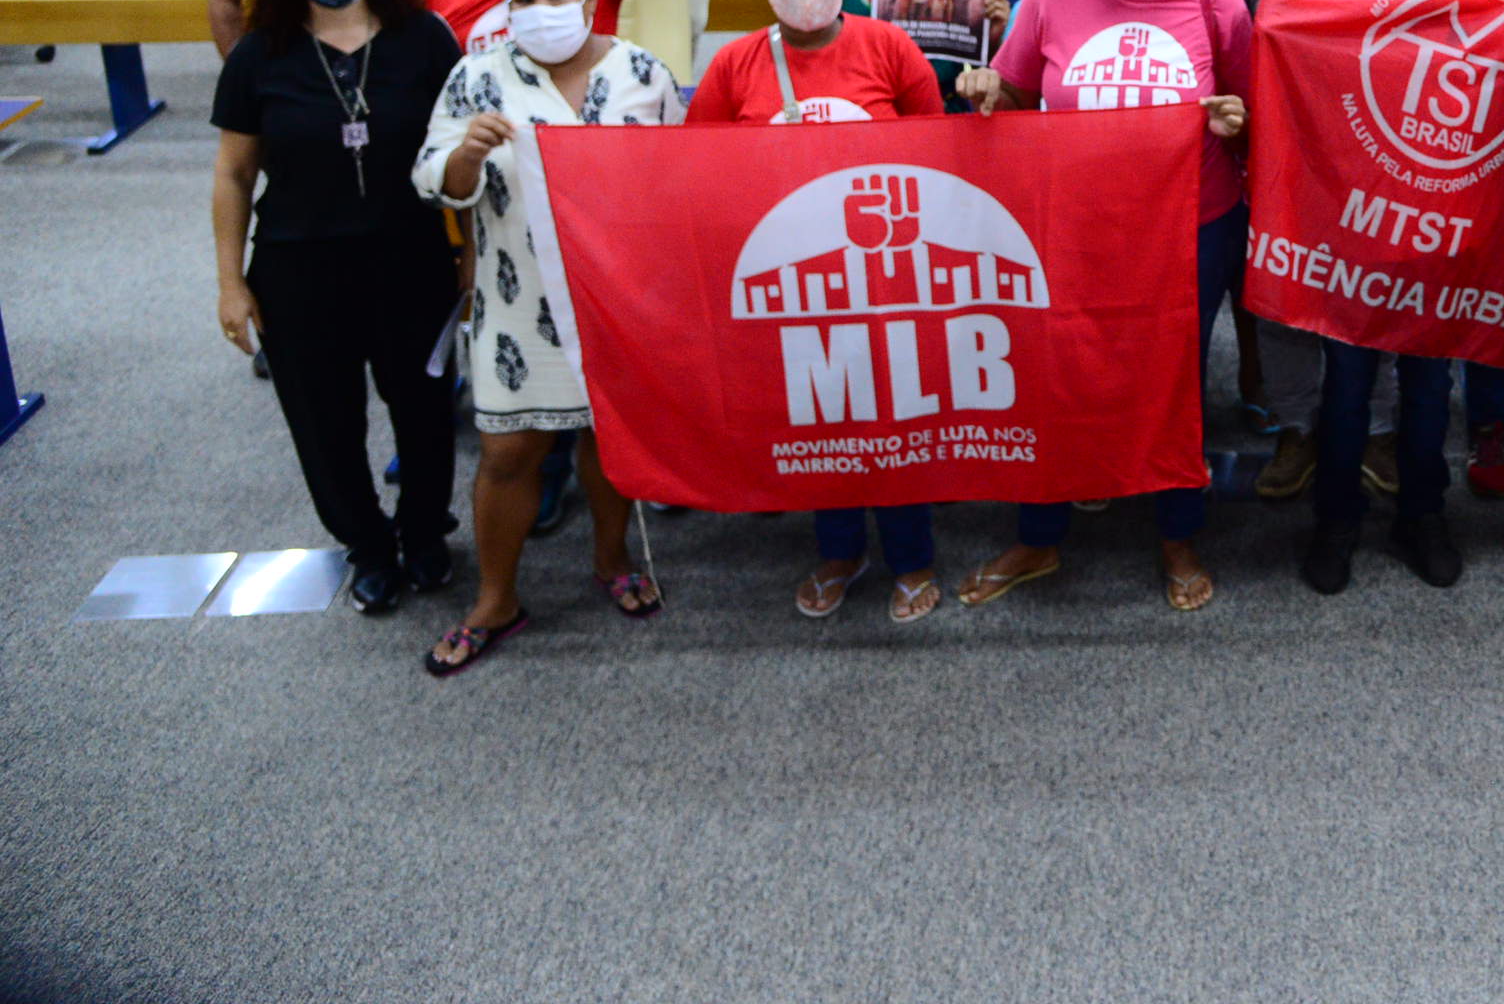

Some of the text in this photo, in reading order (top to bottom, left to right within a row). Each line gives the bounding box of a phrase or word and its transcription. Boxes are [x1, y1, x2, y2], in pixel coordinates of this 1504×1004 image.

[1341, 92, 1357, 119] NA
[1349, 117, 1380, 158] LUTA
[1376, 152, 1412, 186] PELA
[1414, 171, 1479, 194] REFORMA
[1400, 116, 1478, 157] BRASIL
[1339, 187, 1474, 259] MTST
[778, 313, 1017, 427] MLB
[771, 424, 1038, 459] MOVIMENTO DE LUTA NOS
[776, 443, 1037, 476] BAIRROS, VILAS E FAVELAS
